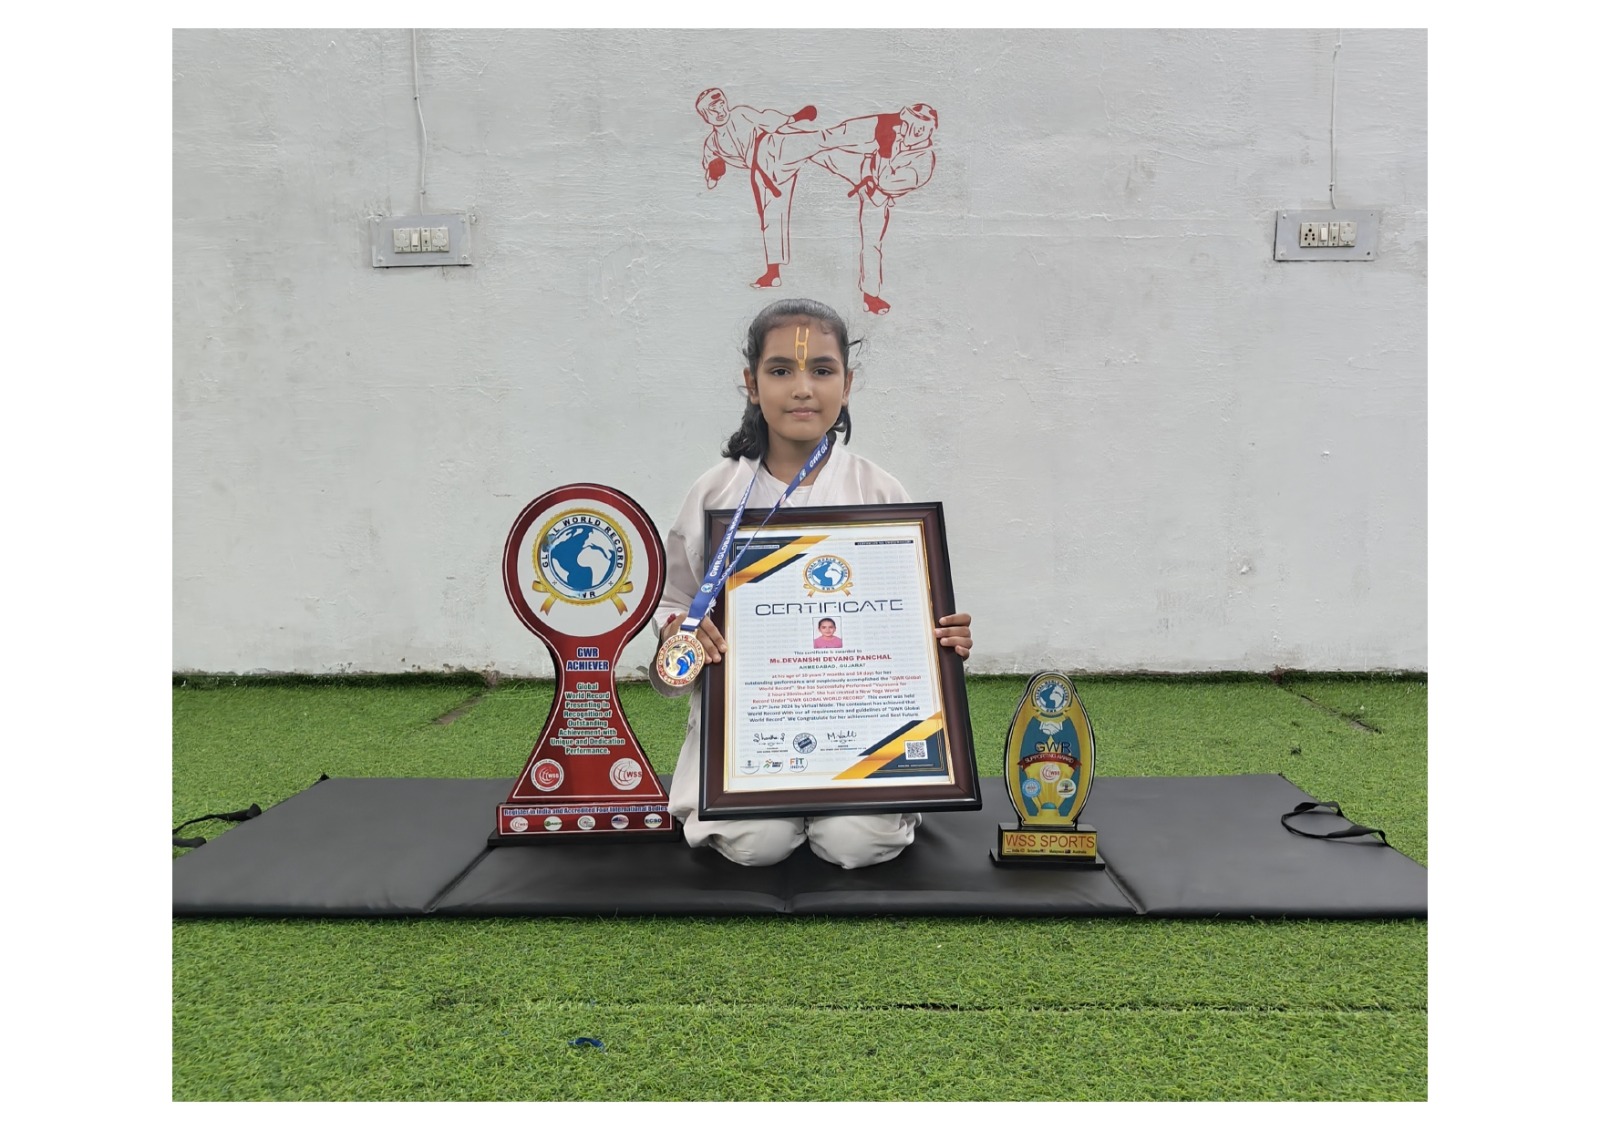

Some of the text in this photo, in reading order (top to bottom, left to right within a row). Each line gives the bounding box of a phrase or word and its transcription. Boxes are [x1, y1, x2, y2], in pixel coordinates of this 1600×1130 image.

[562, 517, 600, 526] WORLD
[605, 526, 624, 569] RECORD
[755, 599, 904, 616] CERTIFICATE
[577, 647, 599, 658] GWR
[566, 660, 610, 671] ACHIEVER
[577, 682, 598, 690] Global
[565, 691, 610, 700] World Record
[565, 700, 601, 710] Presenting
[562, 710, 612, 720] Recognition of
[567, 719, 608, 728] Outstanding
[558, 728, 618, 736] Achievement with
[550, 737, 626, 747] Unique and Dedication
[564, 746, 610, 755] Performance.
[1035, 742, 1072, 753] GWR
[1006, 834, 1095, 848] WSS SPORTS
